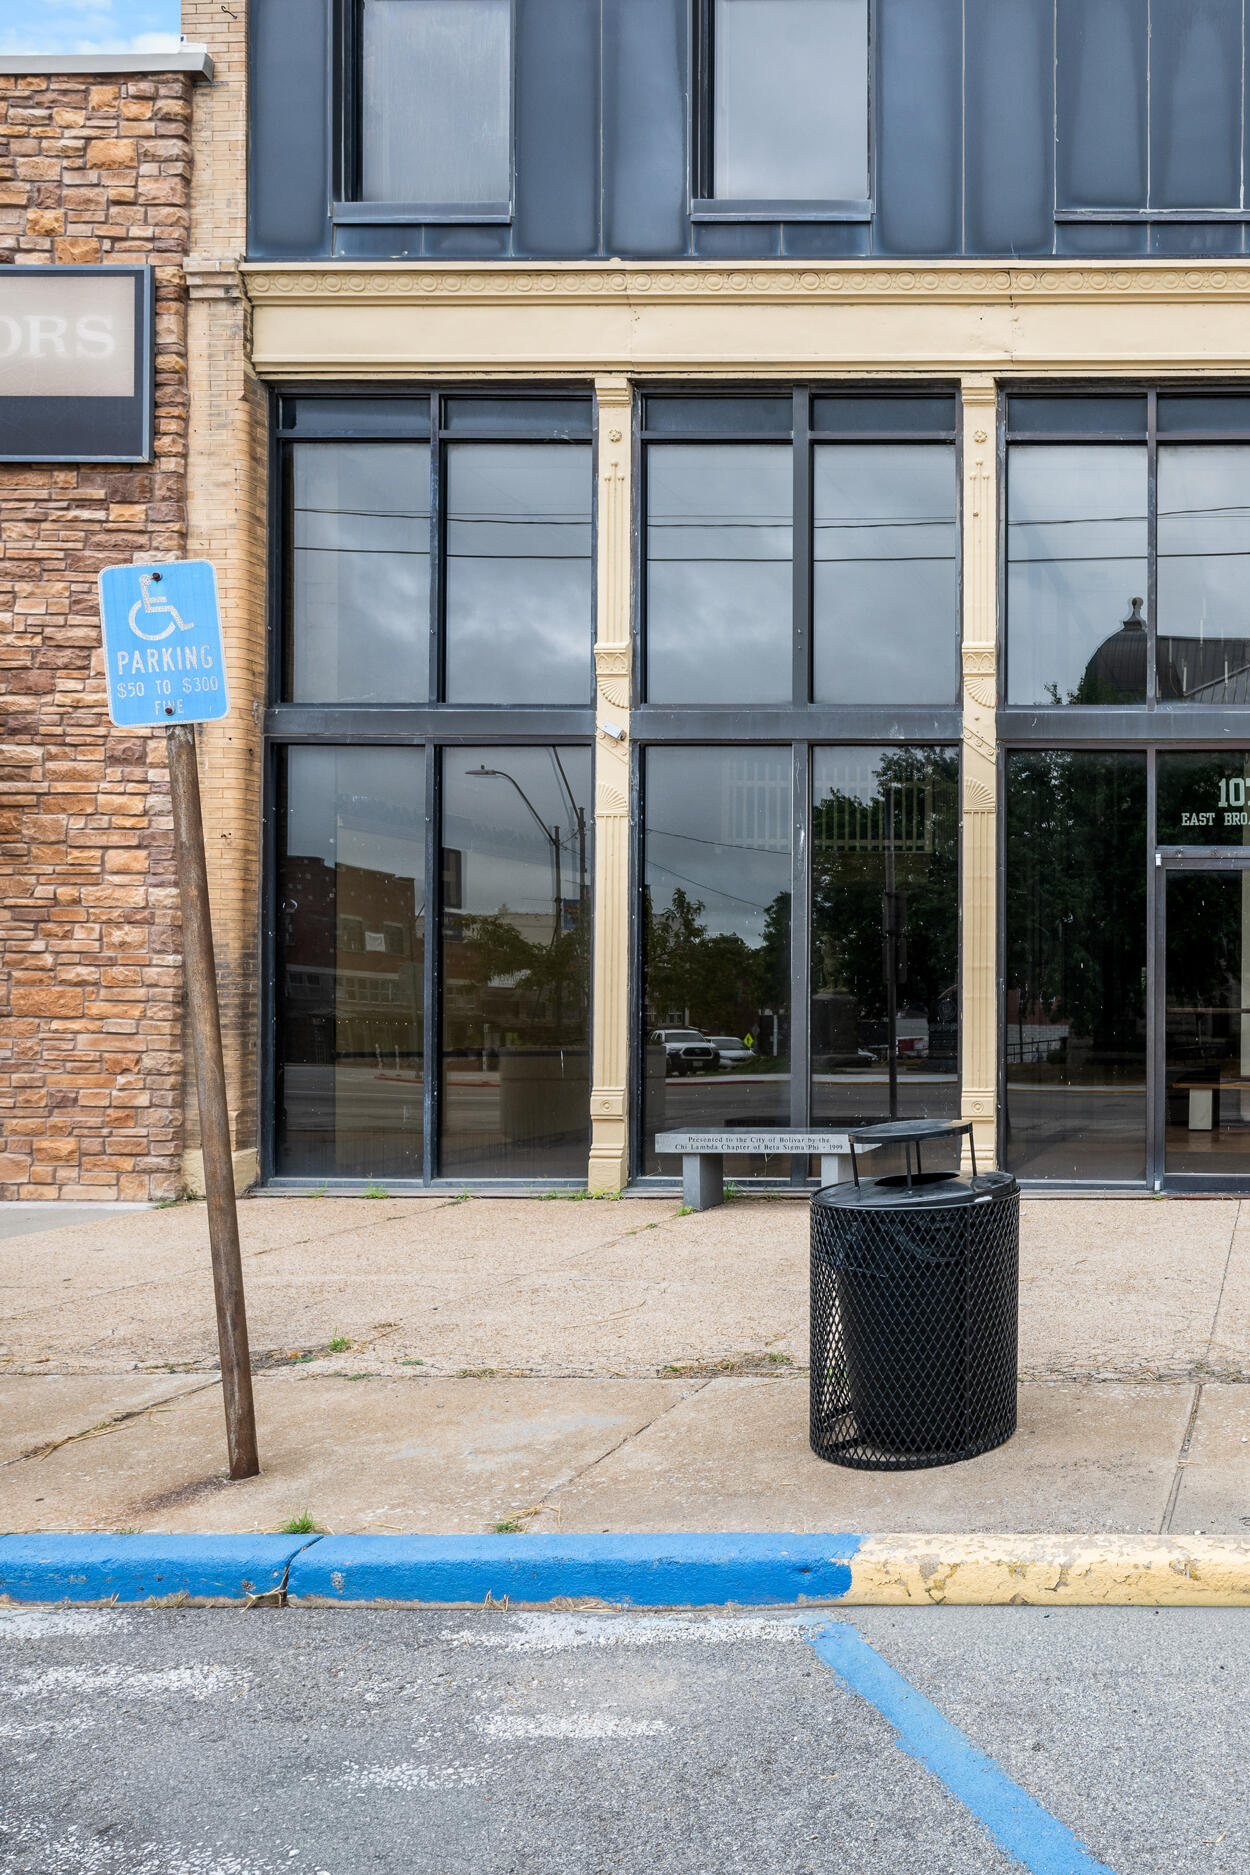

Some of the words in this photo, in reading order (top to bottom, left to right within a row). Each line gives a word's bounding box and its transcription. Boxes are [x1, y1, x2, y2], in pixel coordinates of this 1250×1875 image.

[117, 645, 213, 675] PARKING
[117, 682, 145, 699] $50
[155, 680, 172, 695] TO
[182, 676, 218, 694] $300
[1181, 812, 1215, 826] EAST
[750, 1136, 765, 1144] City
